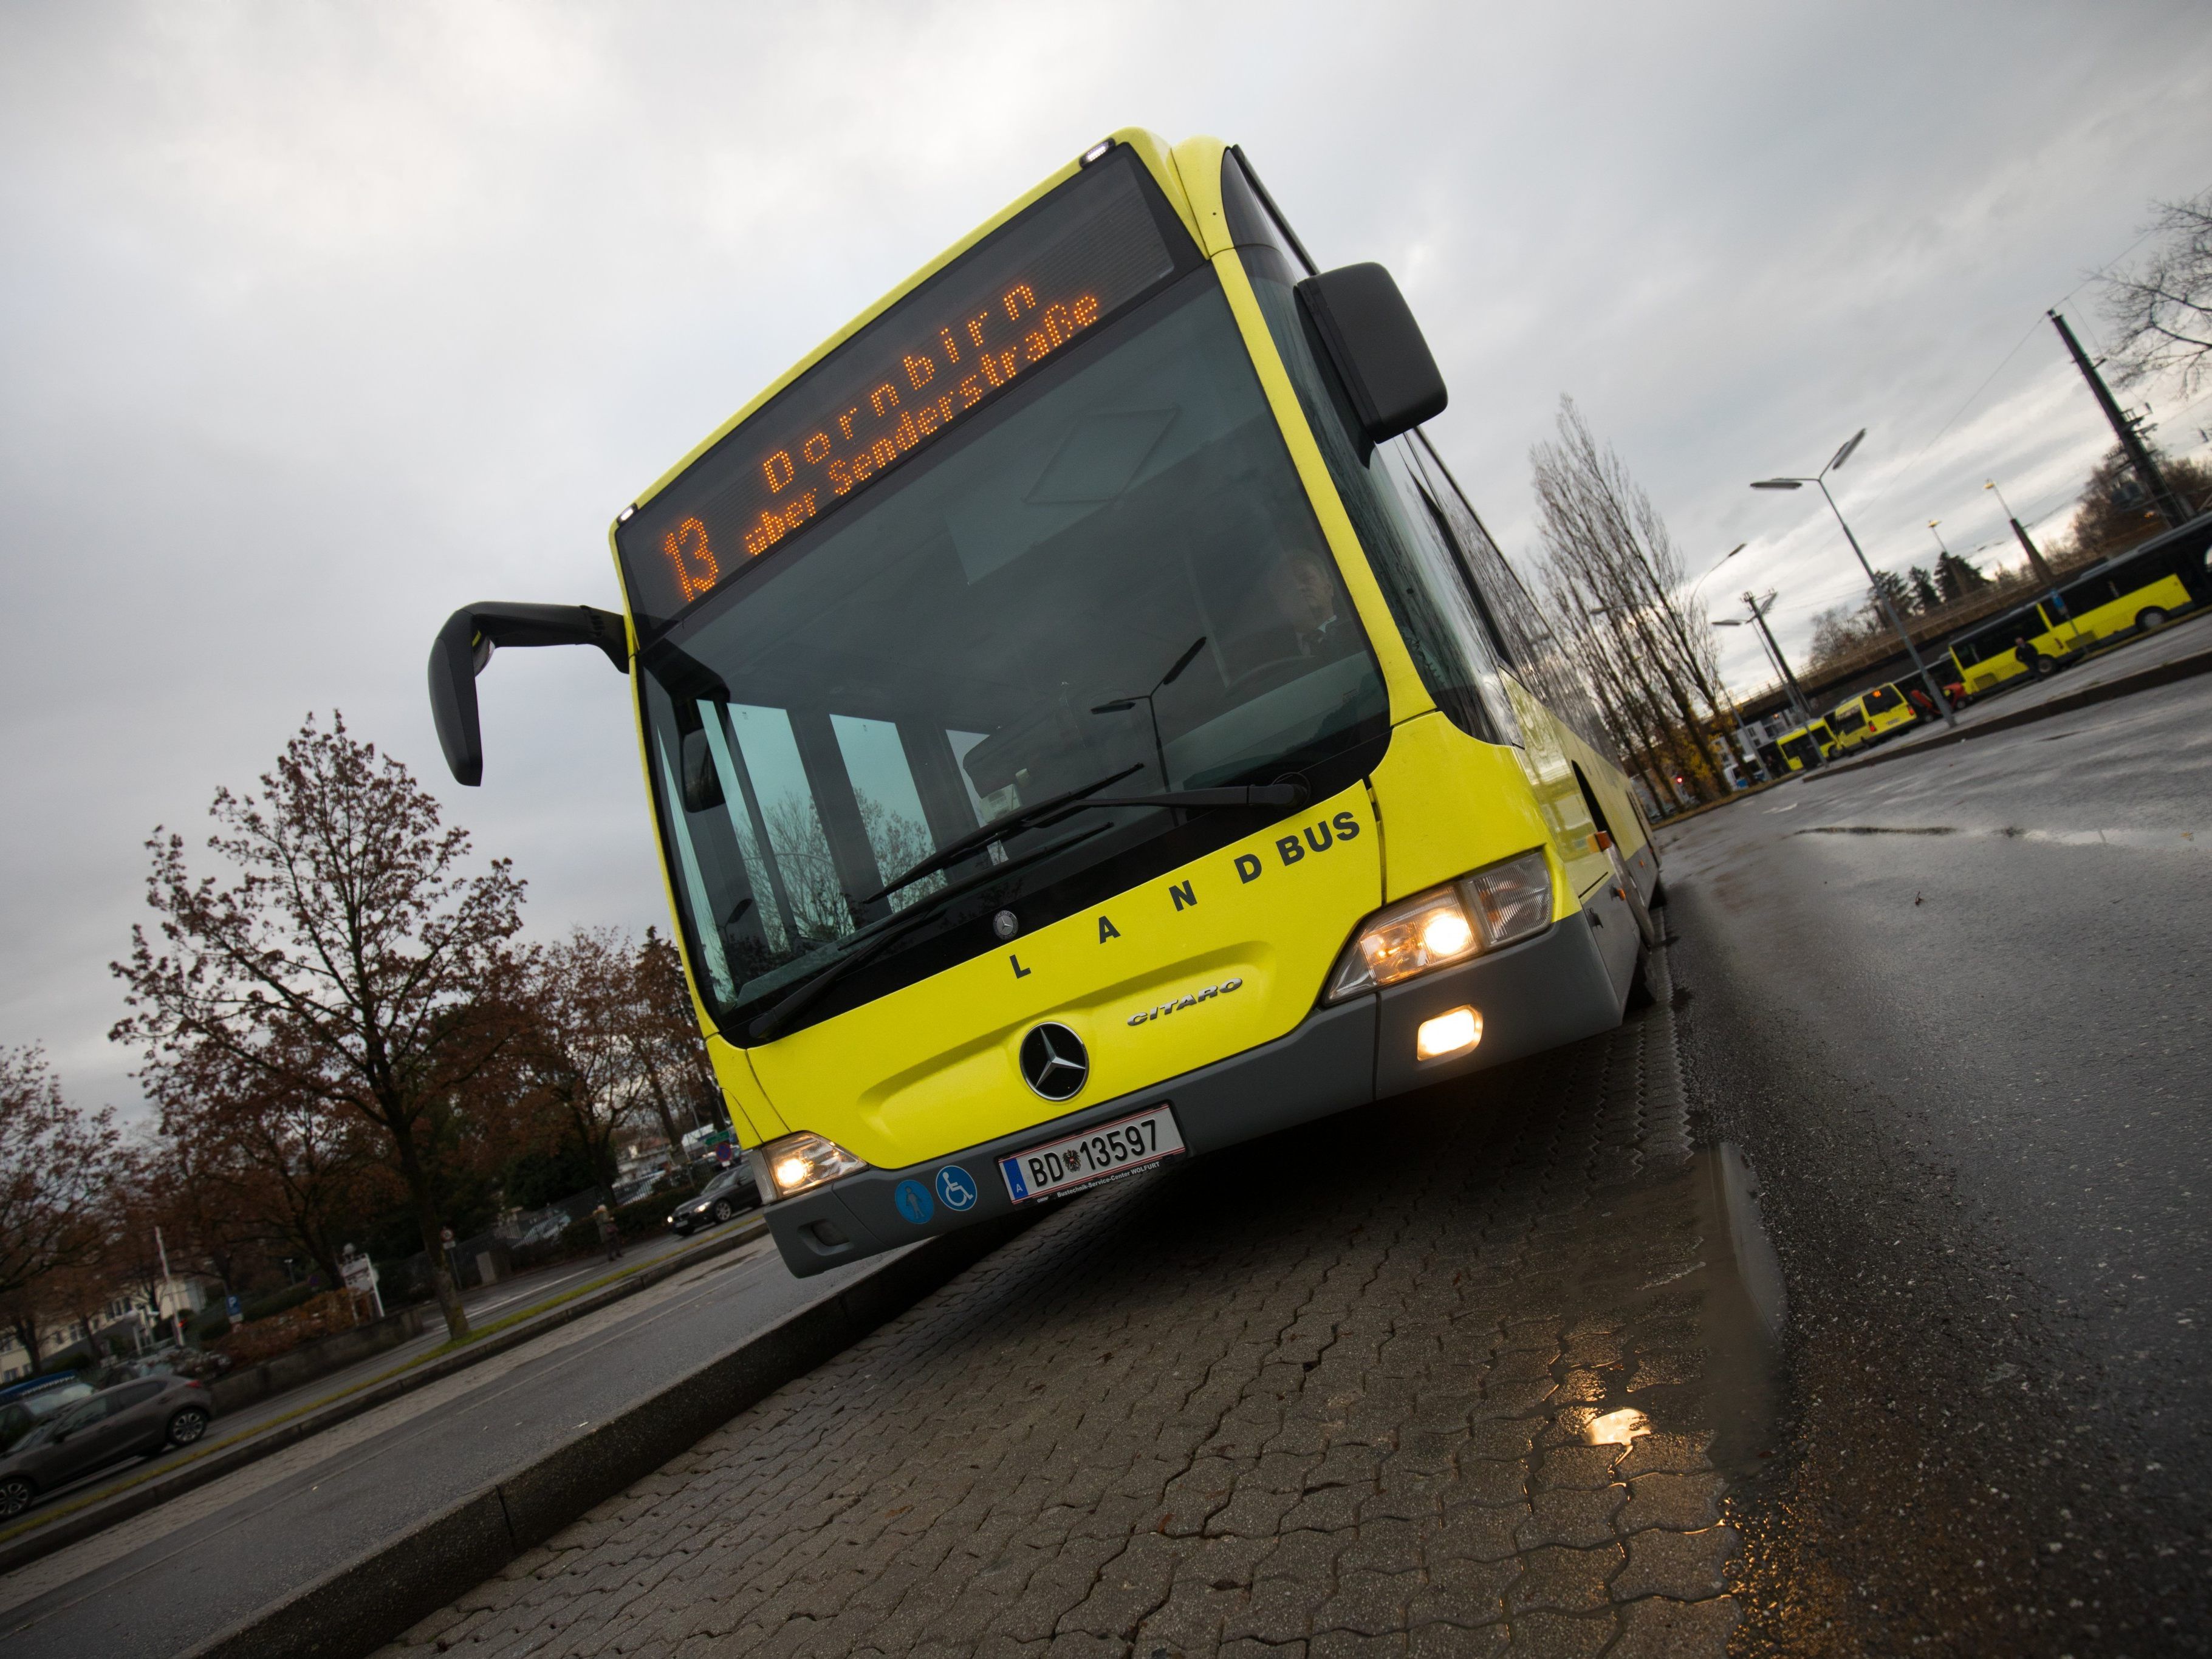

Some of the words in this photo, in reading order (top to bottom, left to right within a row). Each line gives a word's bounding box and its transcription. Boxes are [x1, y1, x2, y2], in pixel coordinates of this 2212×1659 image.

[762, 284, 1037, 494] Dornbirn
[745, 488, 818, 555] über
[829, 295, 1098, 495] Senderstraße
[664, 518, 719, 602] 13
[1127, 977, 1243, 1027] CITARO
[1028, 1152, 1064, 1187] BD
[1080, 1118, 1156, 1171] 13597
[1131, 1161, 1160, 1175] WOLFURT
[1016, 1183, 1023, 1192] A
